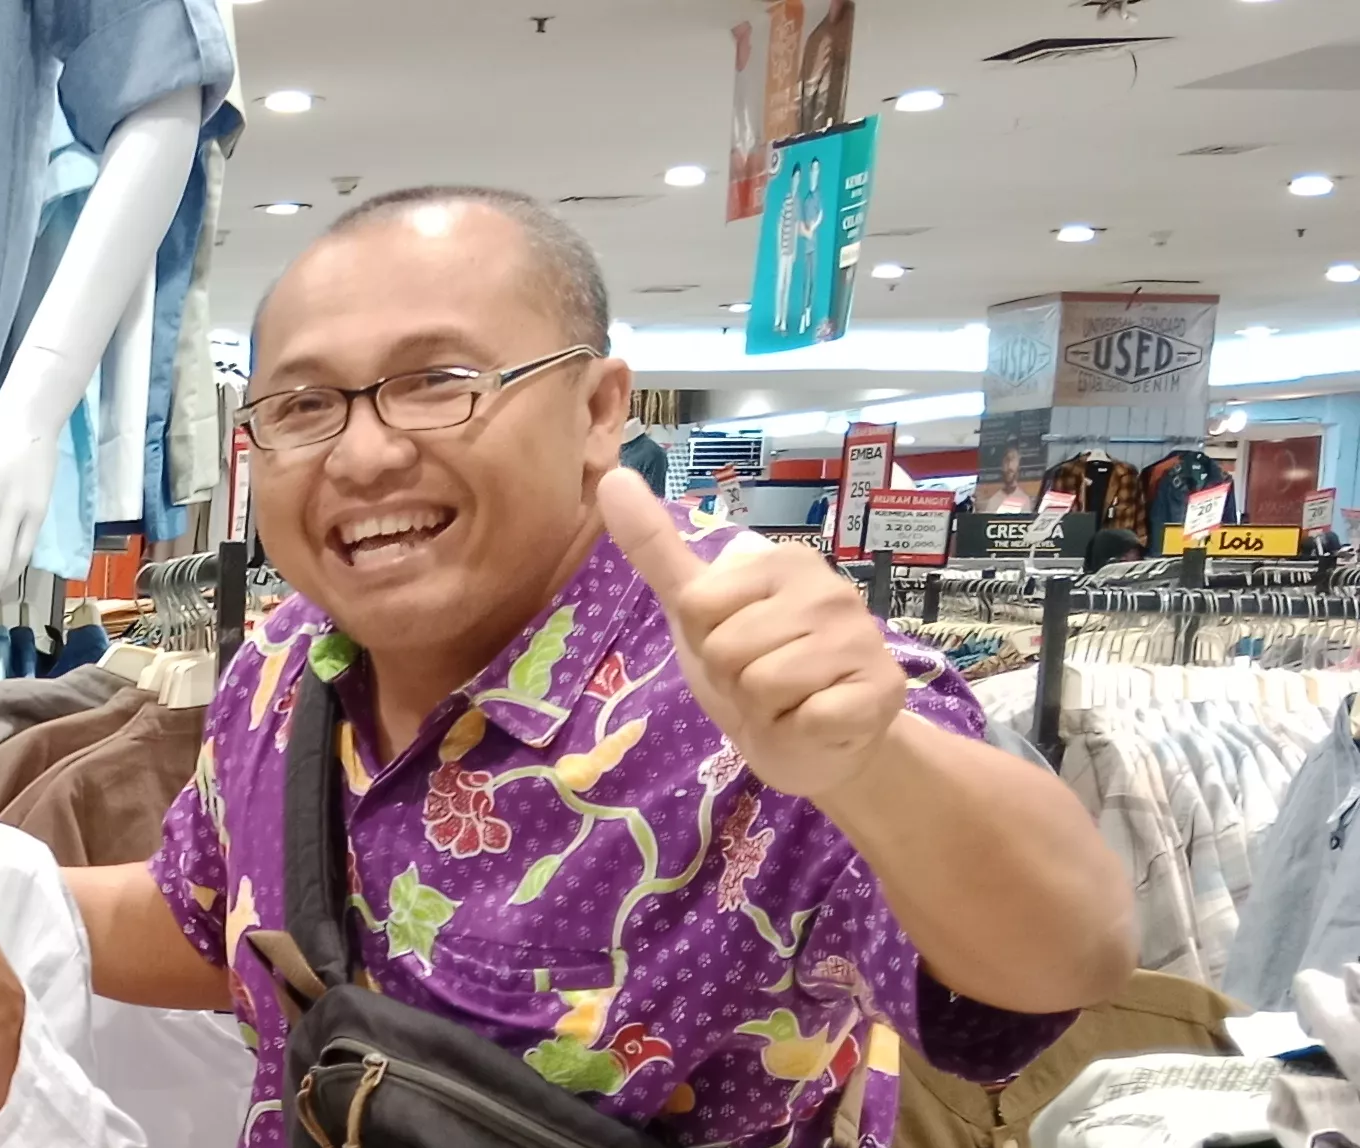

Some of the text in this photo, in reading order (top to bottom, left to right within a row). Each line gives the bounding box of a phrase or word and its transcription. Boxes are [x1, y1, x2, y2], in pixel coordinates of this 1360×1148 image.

[1093, 330, 1174, 378] USED
[850, 446, 883, 461] EMBA
[873, 494, 950, 507] MURAH BANGET
[986, 524, 1065, 539] CRESA
[1219, 531, 1264, 551] Lois
